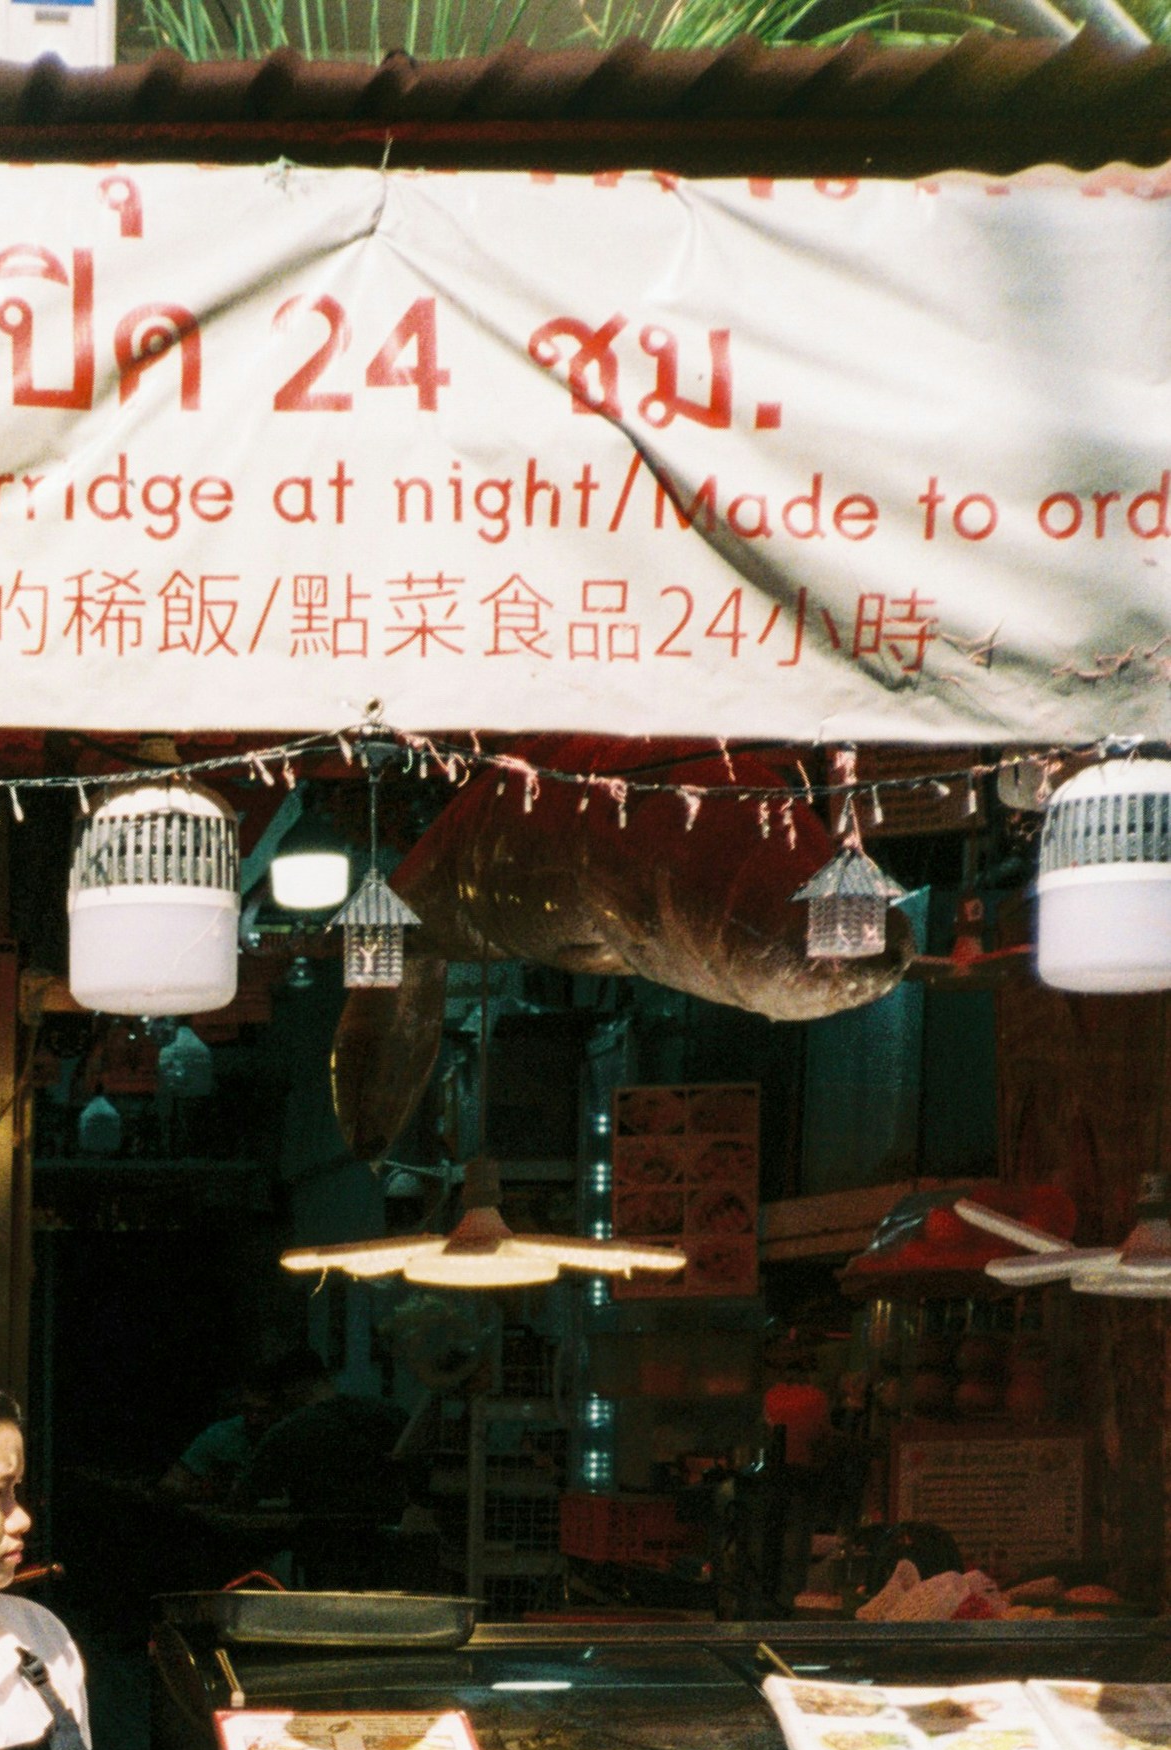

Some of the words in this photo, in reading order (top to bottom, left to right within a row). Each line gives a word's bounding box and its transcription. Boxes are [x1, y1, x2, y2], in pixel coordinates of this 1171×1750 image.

[273, 295, 452, 413] 24
[528, 311, 783, 431] ชม.
[273, 461, 355, 525] at
[394, 457, 880, 545] night/Made
[918, 477, 999, 542] to
[1037, 470, 1171, 541] ord
